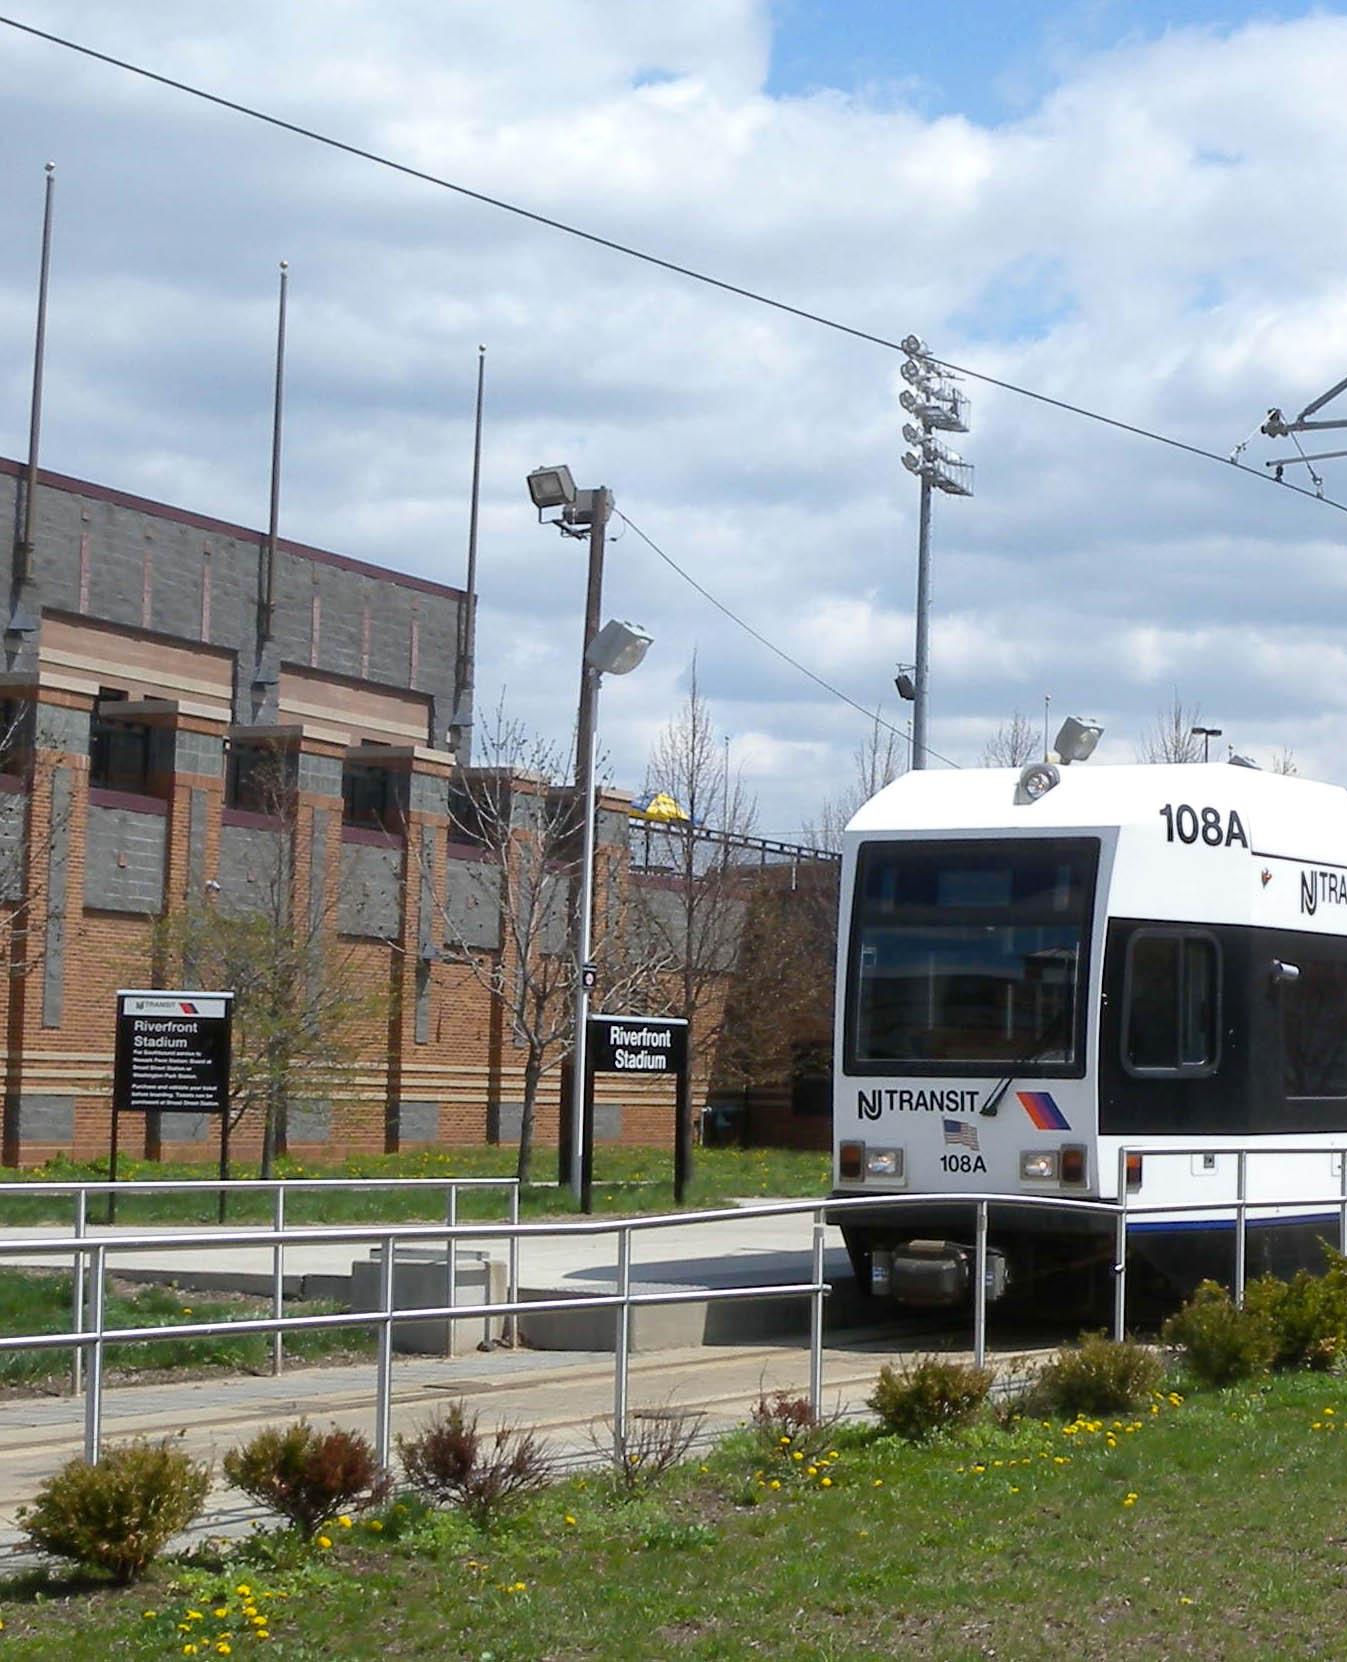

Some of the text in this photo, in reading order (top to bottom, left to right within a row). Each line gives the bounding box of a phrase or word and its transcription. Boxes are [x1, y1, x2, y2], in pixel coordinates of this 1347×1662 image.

[1159, 803, 1249, 849] 108A
[1300, 870, 1317, 916] NJ
[133, 1020, 198, 1033] Riverfront
[609, 1025, 671, 1047] Riverfront
[133, 1035, 188, 1048] Stadium
[614, 1048, 667, 1069] Stadium
[858, 1089, 980, 1121] NJ TRANSIT
[940, 1155, 987, 1174] 108A
